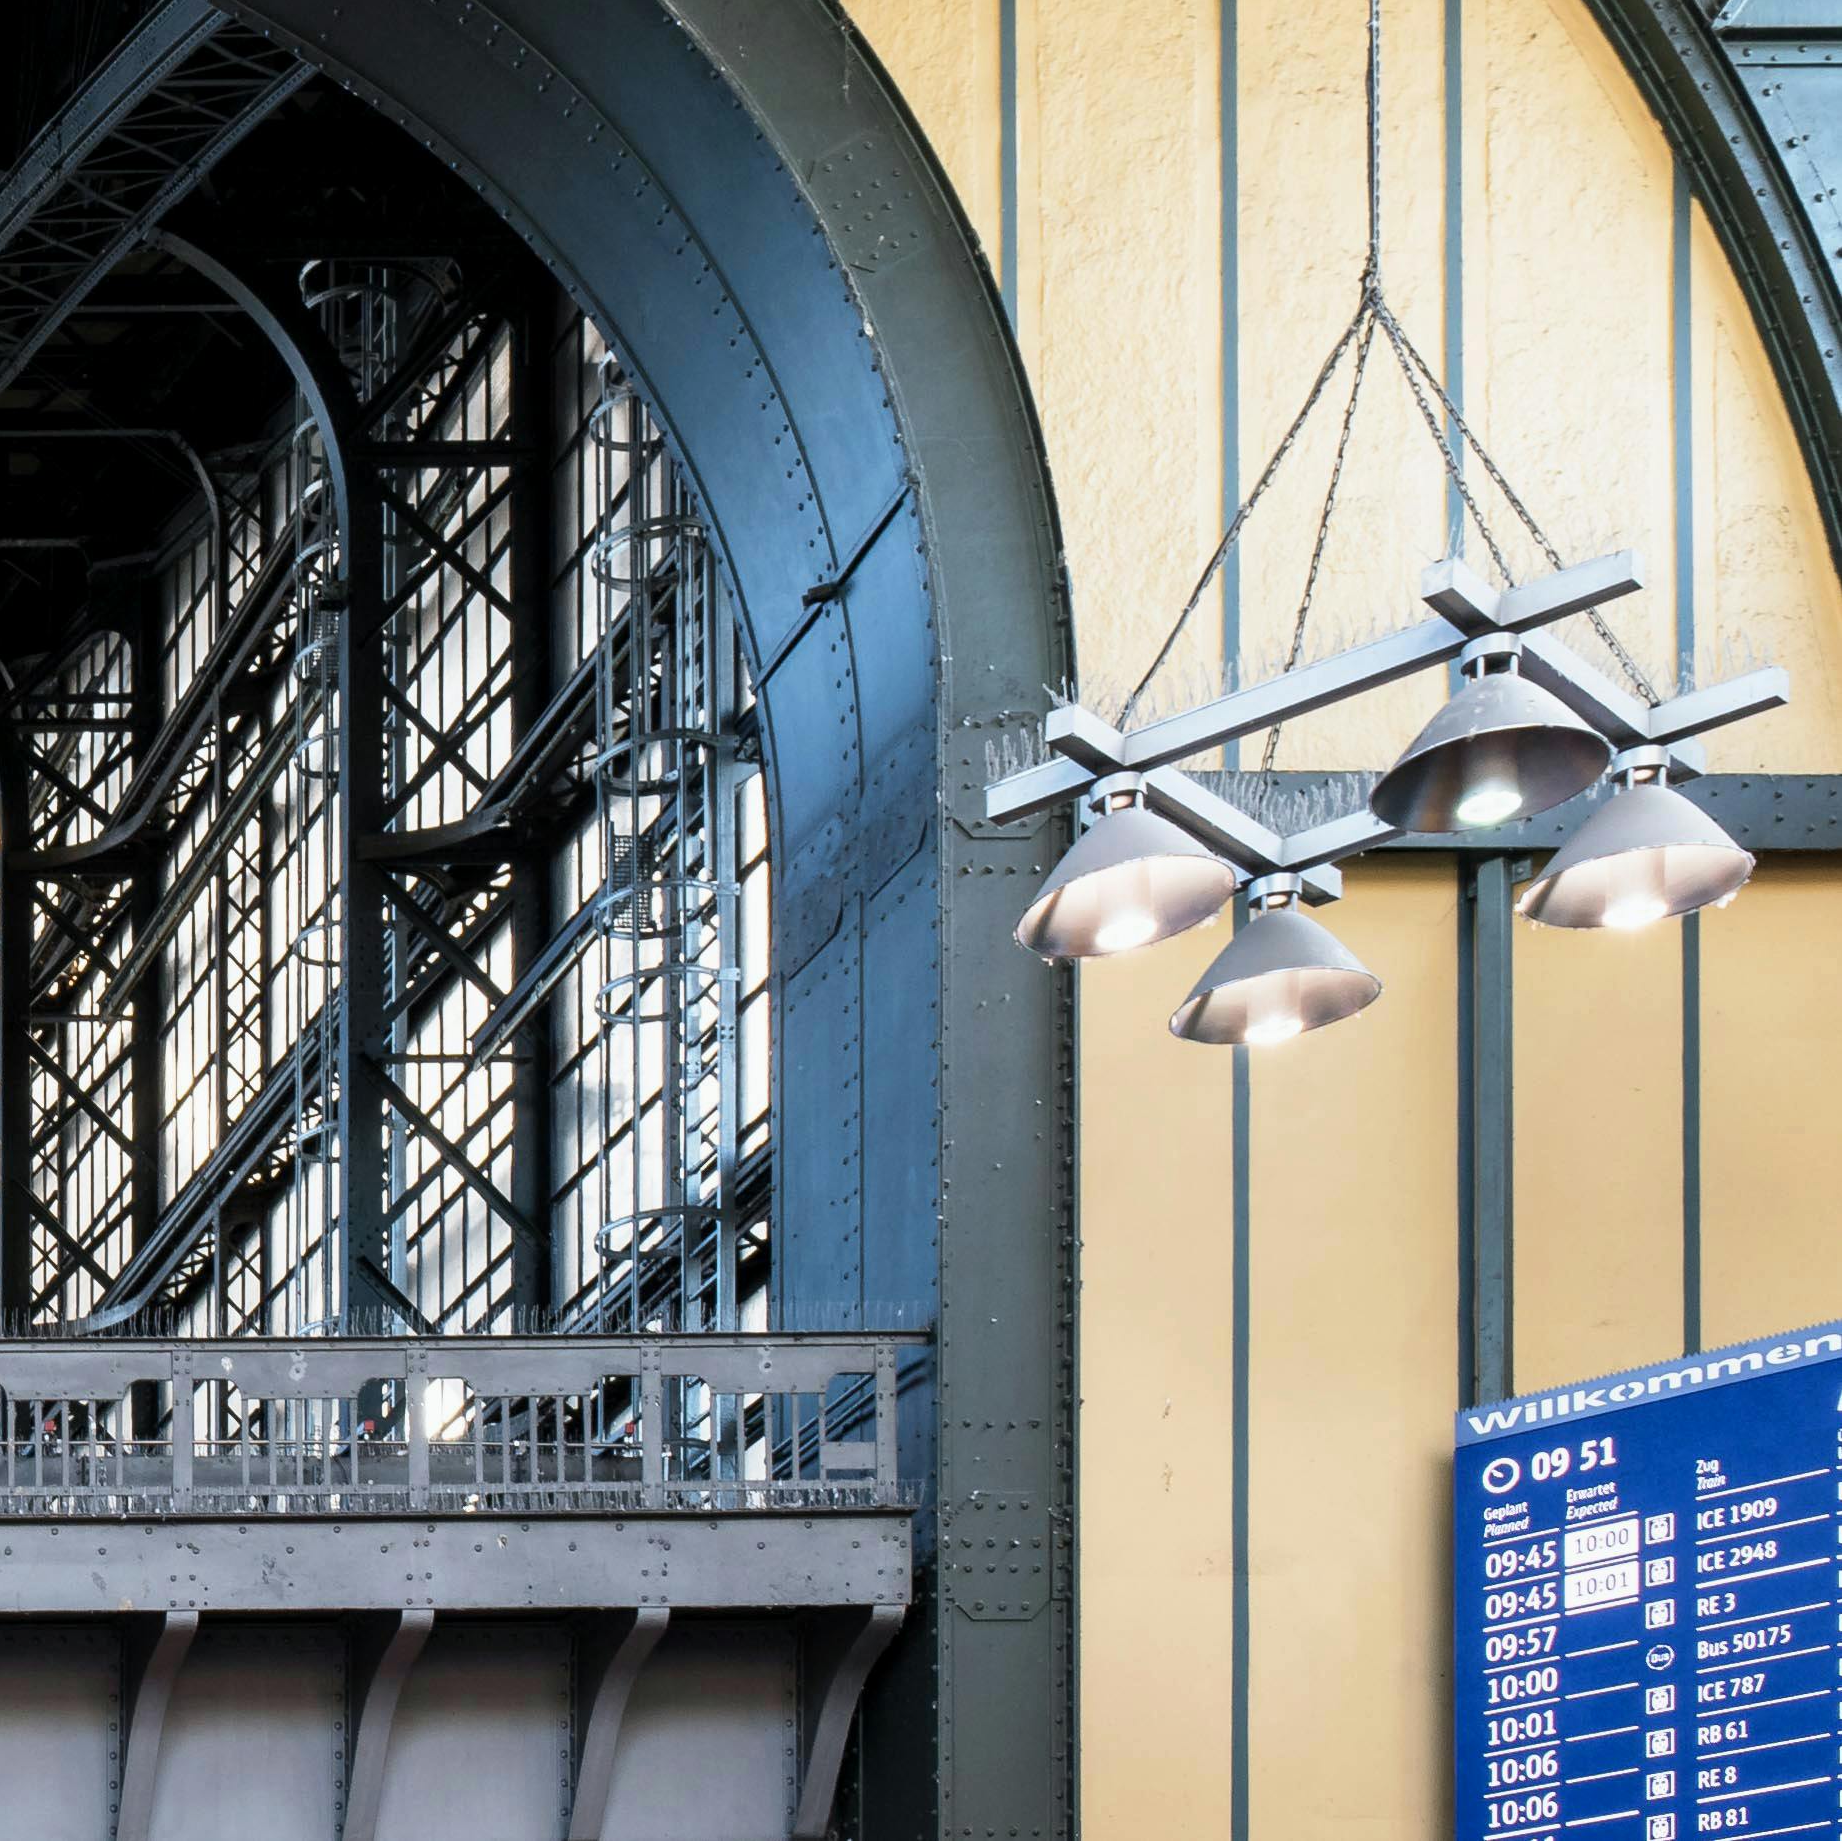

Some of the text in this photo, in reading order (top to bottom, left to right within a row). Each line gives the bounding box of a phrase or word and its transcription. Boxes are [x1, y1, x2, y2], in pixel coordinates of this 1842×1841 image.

[1468, 1333, 1842, 1434] Willkommen
[1531, 1436, 1617, 1481] 09 51
[1696, 1459, 1720, 1475] Zug
[1566, 1481, 1617, 1503] Erwartet
[1697, 1473, 1727, 1491] Train
[1483, 1501, 1529, 1521] Geplant
[1566, 1496, 1619, 1520] Expected
[1697, 1497, 1778, 1531] ICE 1909
[1484, 1516, 1530, 1538] Planned
[1574, 1527, 1630, 1555] 10:00
[1486, 1540, 1557, 1578] 09:45
[1697, 1540, 1777, 1573] ICE 2948
[1574, 1571, 1629, 1597] 10:01
[1486, 1582, 1557, 1619] 09:45
[1697, 1592, 1736, 1617] RE 3
[1485, 1625, 1557, 1661] 09:57
[1697, 1624, 1791, 1660] Bus 50175
[1488, 1667, 1558, 1704] 10:00
[1697, 1673, 1765, 1703] ICE 787
[1488, 1710, 1557, 1746] 10:01
[1698, 1720, 1749, 1746] RB 61
[1488, 1750, 1559, 1787] 10:06
[1698, 1765, 1737, 1789] RE 8
[1488, 1792, 1559, 1829] 10:06
[1698, 1806, 1749, 1832] RB 81
